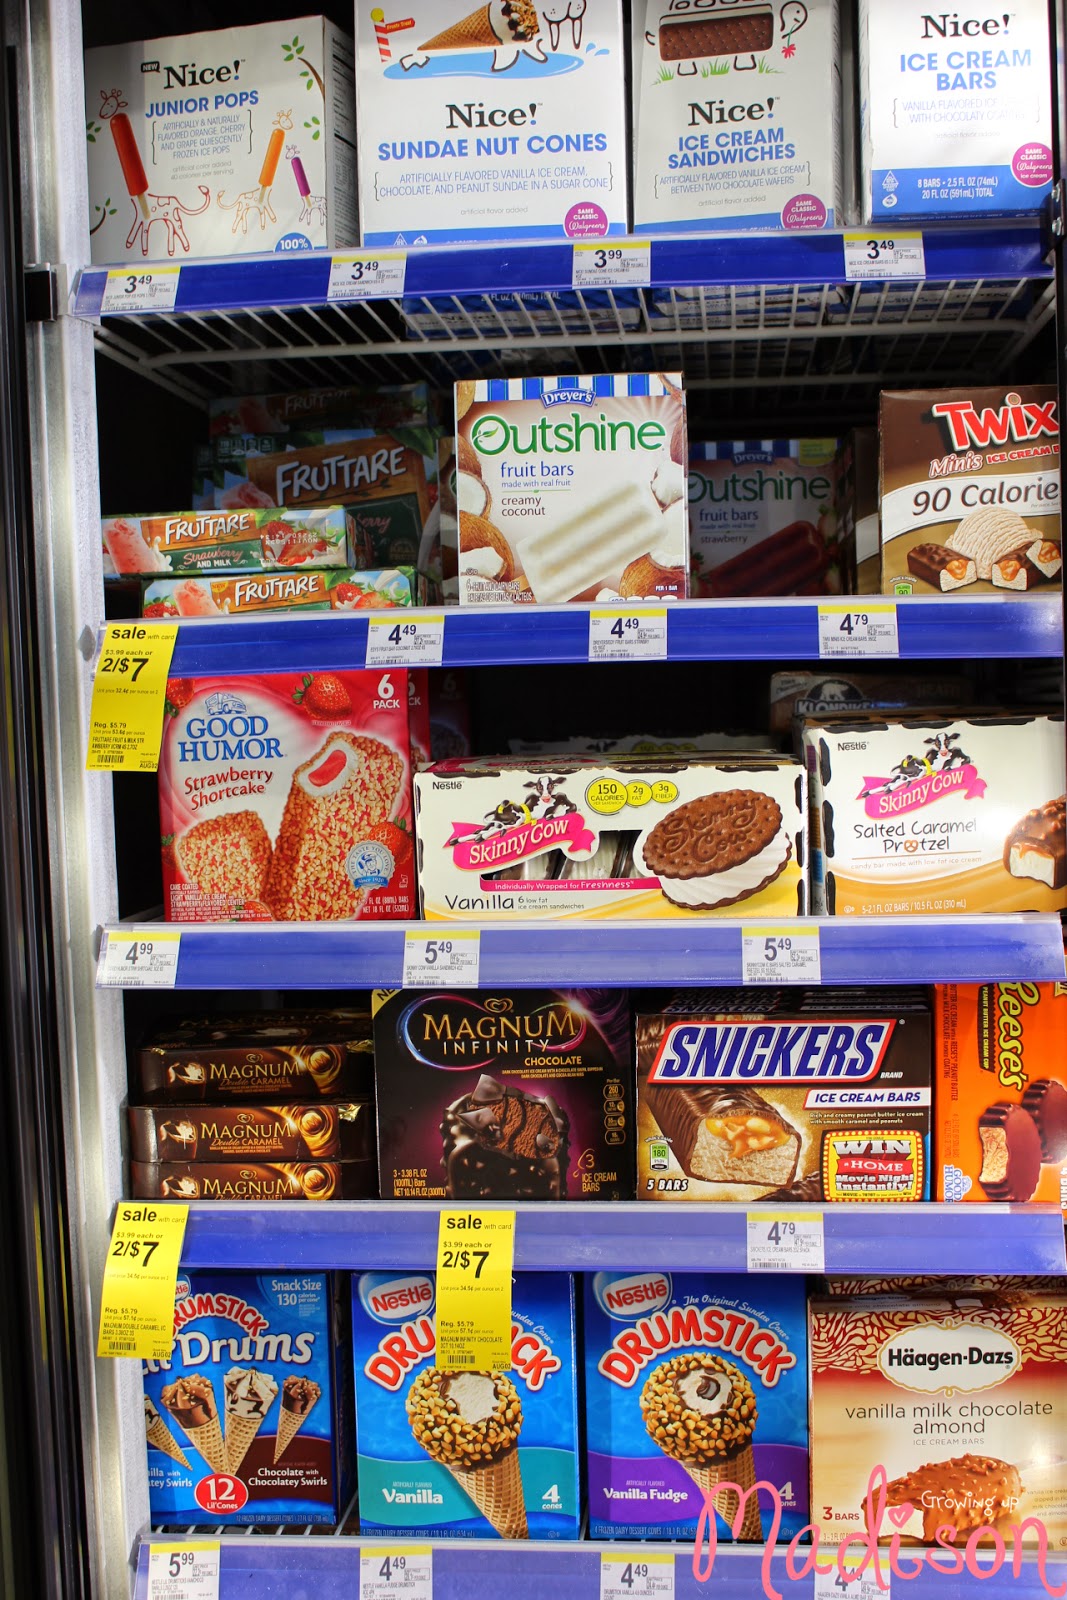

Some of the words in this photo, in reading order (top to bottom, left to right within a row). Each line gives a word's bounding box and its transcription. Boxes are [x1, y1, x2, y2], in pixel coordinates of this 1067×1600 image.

[921, 14, 1010, 39] Nice!
[901, 53, 937, 72] ICE
[947, 49, 1031, 70] CREAM
[164, 60, 240, 89] Nice!
[937, 72, 996, 90] BARS
[146, 98, 209, 118] JUNIOR
[215, 91, 258, 110] POPS
[688, 98, 774, 126] Nice!
[446, 104, 536, 128] Nice!
[158, 131, 188, 141] FLAVORED
[220, 124, 245, 133] CHERRY
[679, 136, 708, 151] ICE
[715, 128, 783, 148] CREAM
[378, 140, 468, 160] SUNDAE
[477, 137, 519, 156] NUT
[527, 134, 607, 154] CONES
[668, 144, 795, 169] SANDWICHES
[400, 172, 451, 183] ARTIFICIALLY
[455, 170, 498, 181] FLAVORED
[501, 169, 535, 178] VANILLA
[538, 168, 552, 177] ICE
[918, 179, 921, 187] 8
[924, 179, 941, 187] BARS
[947, 179, 957, 187] 2.5
[967, 178, 976, 186] OZ
[922, 190, 930, 199] 20
[932, 190, 938, 198] FL
[939, 190, 948, 198] OZ
[976, 188, 993, 196] TOTAL
[280, 239, 308, 250] 100%
[544, 391, 593, 405] Dreyer's
[471, 413, 666, 455] Outshine
[501, 462, 536, 478] fruit
[541, 462, 574, 477] bars
[929, 453, 982, 477] Minis
[987, 453, 1007, 464] ICE
[1010, 447, 1050, 461] CREAM
[276, 446, 406, 505] FRUTTARE
[502, 496, 541, 507] creamy
[913, 486, 951, 515] 90
[502, 507, 545, 516] coconut
[700, 510, 728, 523] fruit
[731, 508, 758, 521] bars
[165, 513, 249, 544] FRUTTARE
[701, 533, 747, 544] strawberry
[183, 549, 243, 565] Strawberry
[197, 560, 211, 568] AND
[214, 558, 231, 567] MILK
[235, 575, 319, 606] FRUTTARE
[112, 627, 146, 639] sale
[378, 675, 394, 696] 6
[373, 700, 400, 709] PACK
[186, 716, 269, 738] GOOD
[179, 738, 283, 761] HUMOR
[185, 768, 273, 794] Strawberry
[598, 784, 616, 794] 150
[659, 784, 668, 793] 3g
[191, 783, 265, 810] Shortcake
[633, 786, 643, 795] 2g
[879, 785, 930, 814] Skinny
[854, 825, 905, 839] Salted
[912, 820, 976, 835] Caramel
[470, 831, 529, 864] Skinny
[445, 894, 514, 910] Vanilla
[423, 1011, 575, 1040] MAGNUM
[444, 1039, 549, 1055] INFINITY
[663, 1025, 885, 1078] SNICKERS
[525, 1056, 582, 1065] CHOCOLATE
[210, 1062, 300, 1080] MAGNUM
[815, 1094, 836, 1103] ICE
[839, 1093, 884, 1102] CREAM
[887, 1092, 920, 1102] BARS
[201, 1123, 293, 1139] MAGNUM
[833, 1140, 911, 1155] WIN
[851, 1161, 903, 1171] HOME
[647, 1179, 654, 1190] 5
[657, 1178, 688, 1191] BARS
[836, 1174, 876, 1182] Movie
[879, 1173, 914, 1182] Night
[203, 1179, 295, 1195] MAGNUM
[836, 1182, 913, 1192] Instantly!
[123, 1208, 157, 1222] sale
[447, 1215, 482, 1229] sale
[271, 1280, 300, 1292] Snack
[303, 1280, 321, 1290] Size
[174, 1294, 268, 1336] RUMSTICK
[179, 1330, 315, 1367] Drums
[602, 1308, 793, 1384] DRUMSTICK
[889, 1347, 1014, 1370] Häagen-Dazs
[845, 1404, 905, 1418] vanilla
[913, 1402, 951, 1417] milk
[959, 1401, 1053, 1417] chocolate
[913, 1418, 985, 1434] almond
[258, 1467, 303, 1476] Chocolate
[206, 1479, 236, 1500] 12
[248, 1478, 291, 1487] Chocolatey
[293, 1477, 327, 1486] Swirls
[383, 1487, 443, 1505] Vanilla
[542, 1485, 560, 1503] 4
[603, 1488, 647, 1500] Vanilla
[650, 1488, 688, 1500] Fudge
